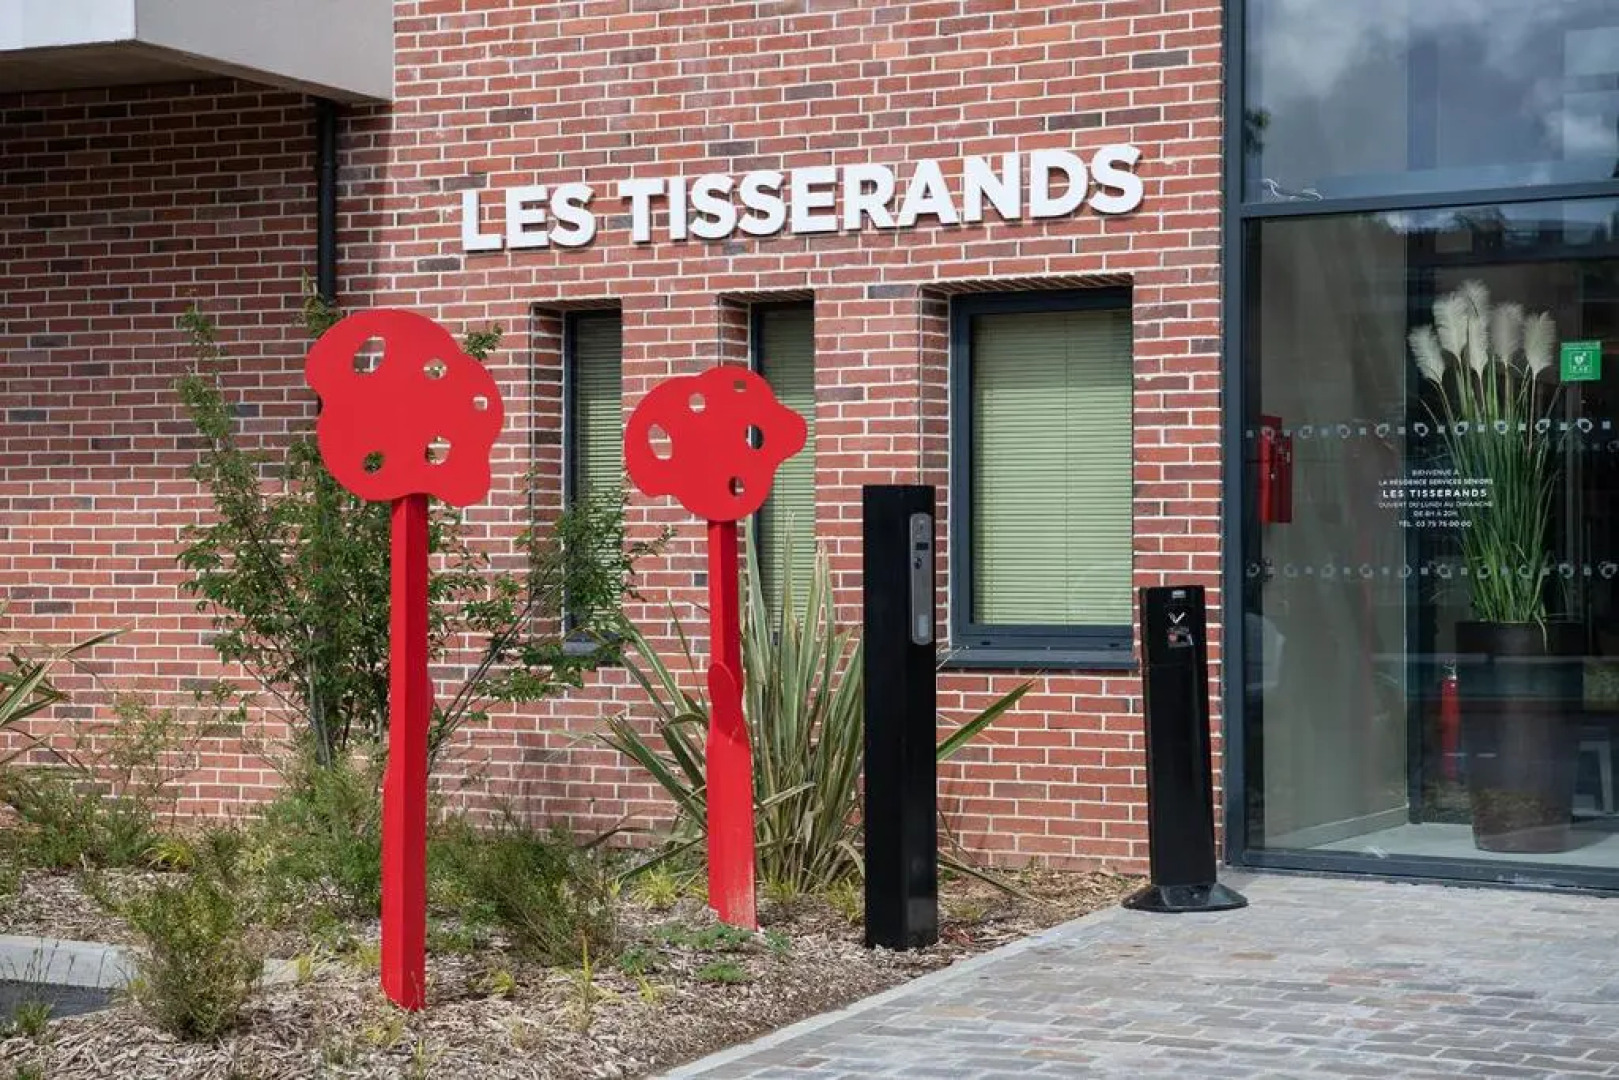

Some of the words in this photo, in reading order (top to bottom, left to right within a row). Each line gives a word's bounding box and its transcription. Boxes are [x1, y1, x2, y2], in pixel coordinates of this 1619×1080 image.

[461, 182, 597, 250] LES
[617, 144, 1145, 242] TISSERANDS
[1382, 489, 1404, 498] LES
[1409, 489, 1487, 498] TISSERANDS
